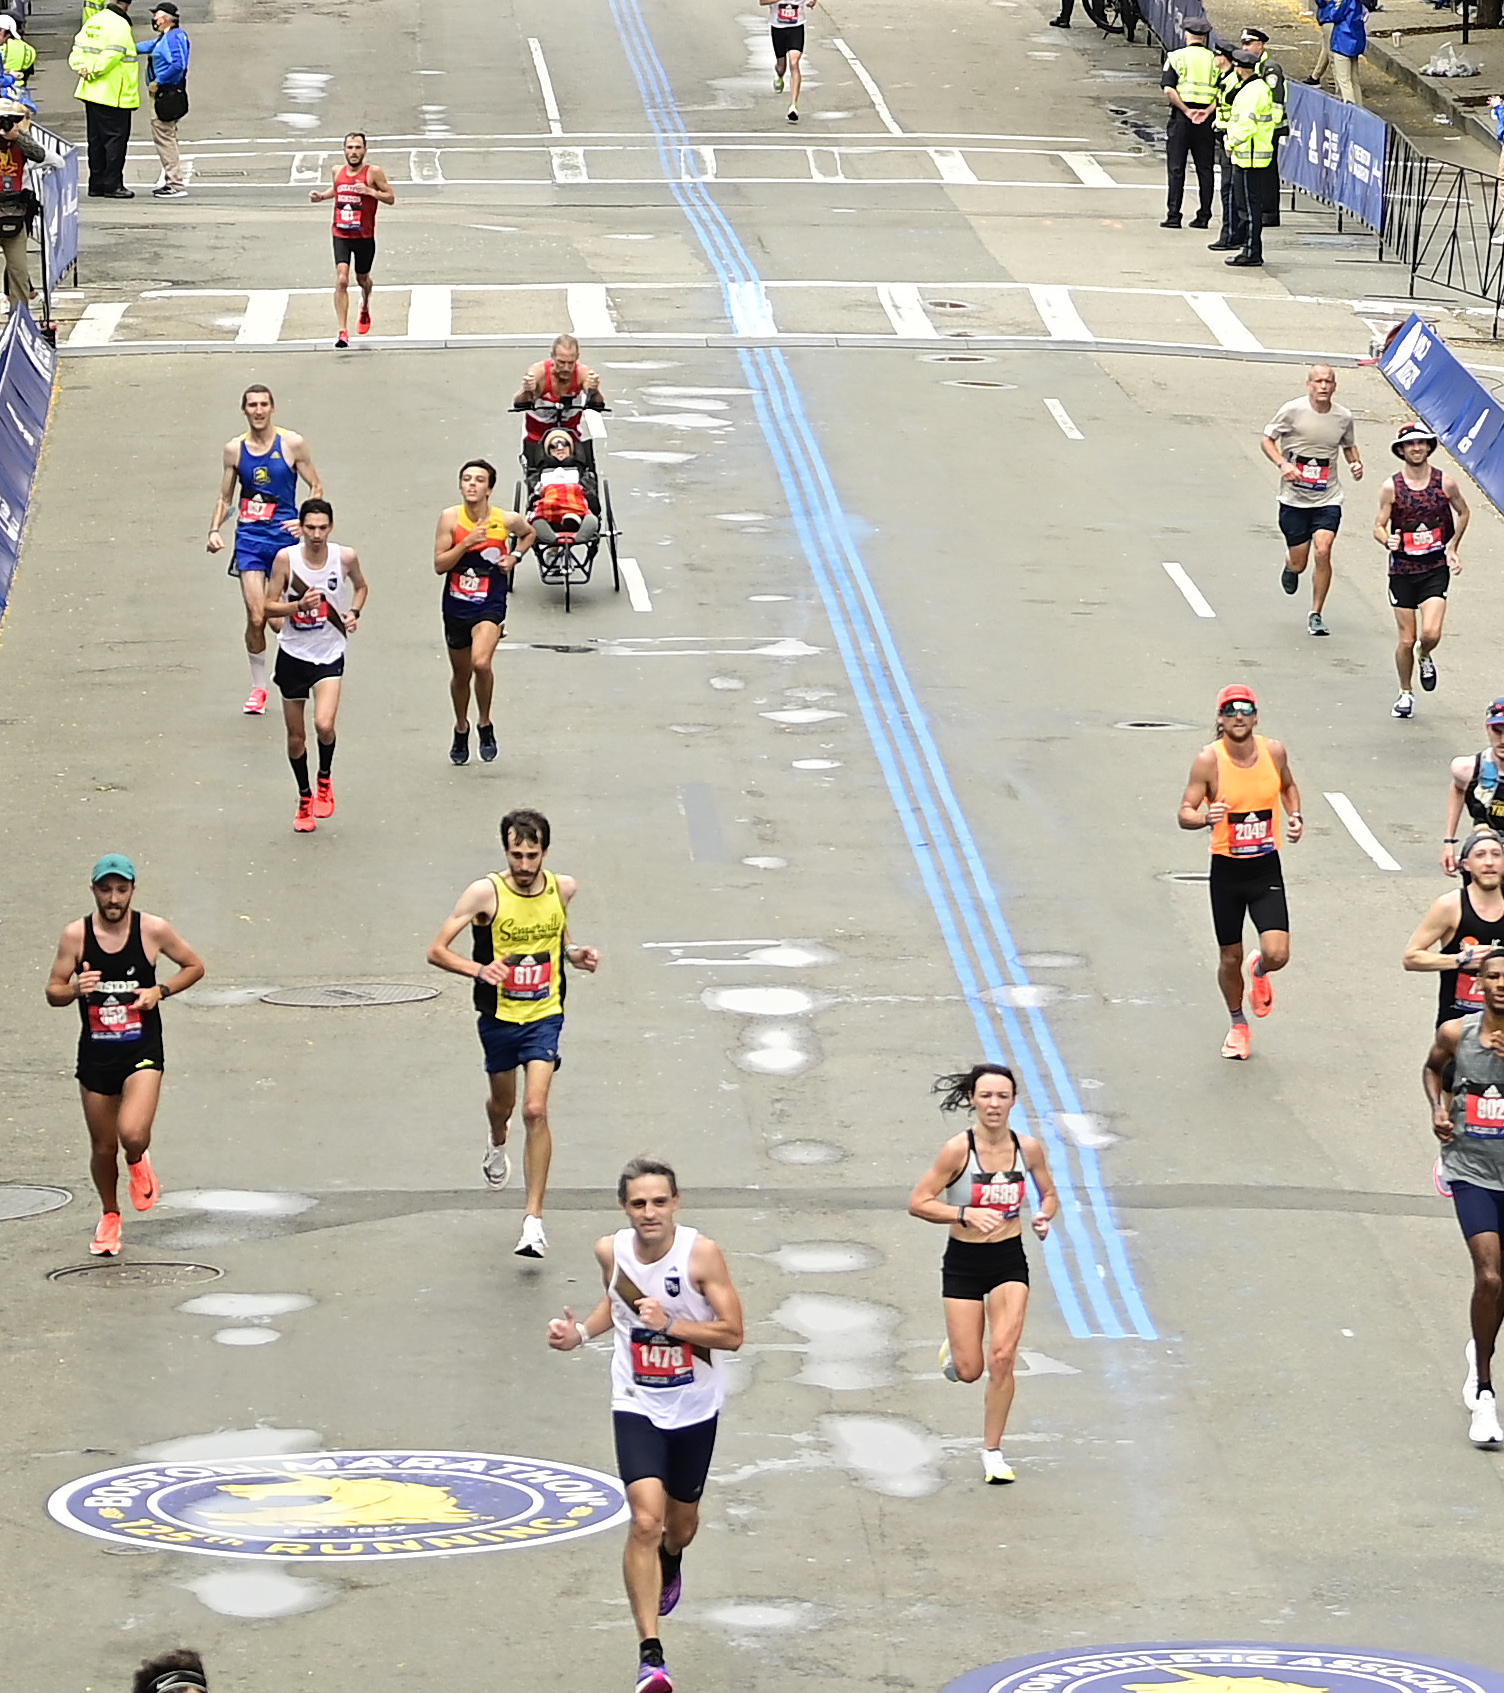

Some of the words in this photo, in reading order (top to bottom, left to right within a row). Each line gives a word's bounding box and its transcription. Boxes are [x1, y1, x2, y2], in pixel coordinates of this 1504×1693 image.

[82, 1460, 261, 1509] BOSTON
[281, 1455, 607, 1508] MARATHON
[112, 1515, 244, 1547] 125th
[264, 1513, 579, 1556] RUNNING
[1065, 1651, 1278, 1678] ATHLETIC
